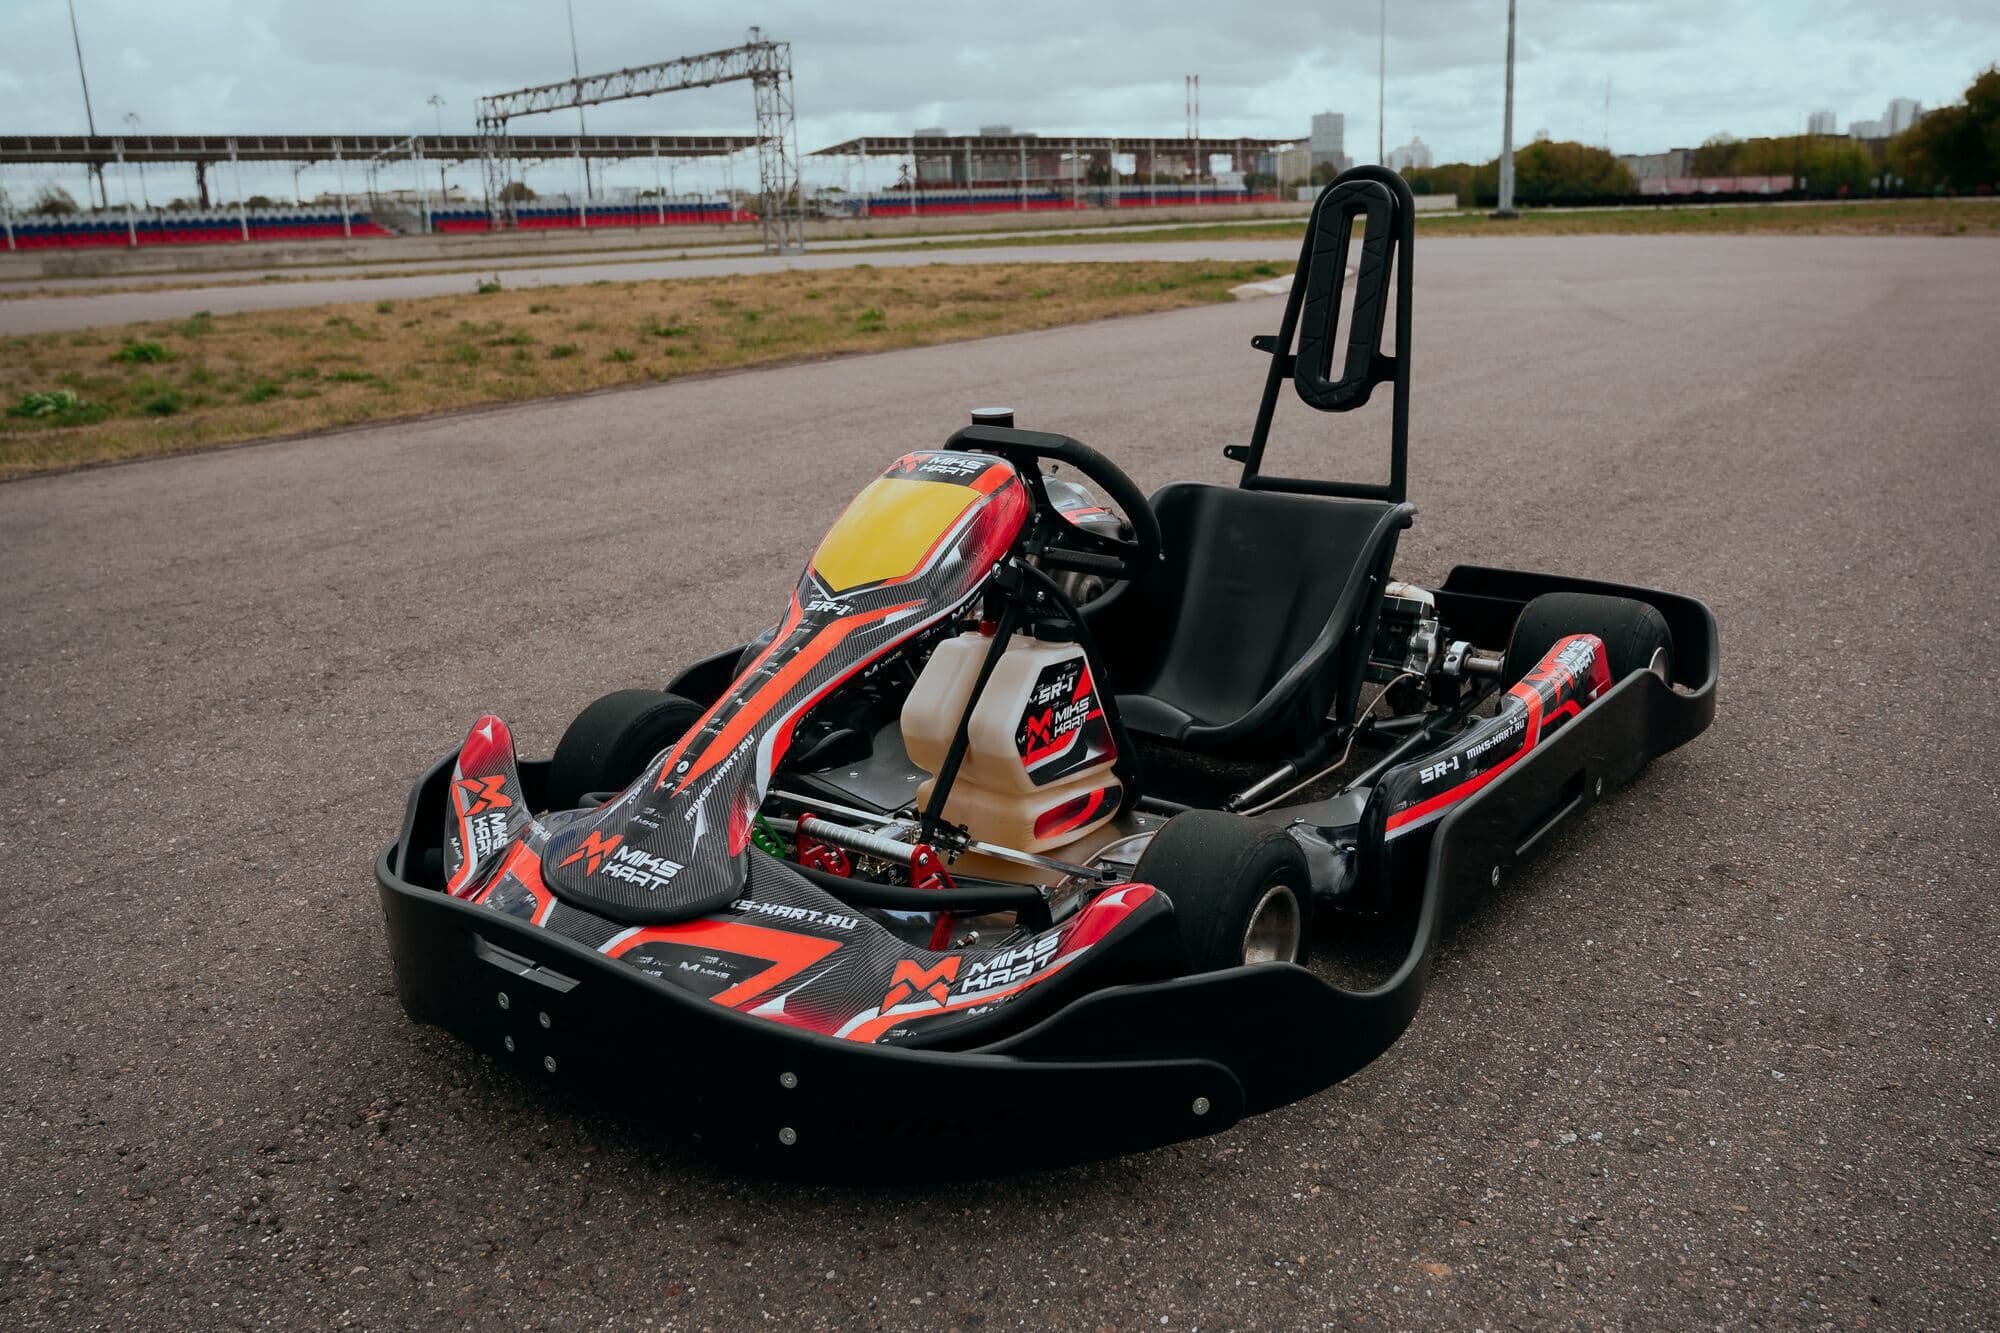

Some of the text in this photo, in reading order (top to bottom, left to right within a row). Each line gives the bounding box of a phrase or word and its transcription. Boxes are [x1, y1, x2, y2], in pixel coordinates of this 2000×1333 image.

[928, 456, 987, 470] MIKS
[805, 600, 850, 615] SR-1
[1038, 676, 1074, 705] SR-1
[1054, 710, 1090, 738] KART
[1055, 696, 1090, 725] MIKS
[1419, 756, 1459, 784] SR-1
[489, 812, 508, 850] MIKS
[601, 861, 671, 890] KART
[613, 845, 685, 878] MIKS
[968, 930, 1063, 976] MIKS
[961, 947, 1058, 993] KART
